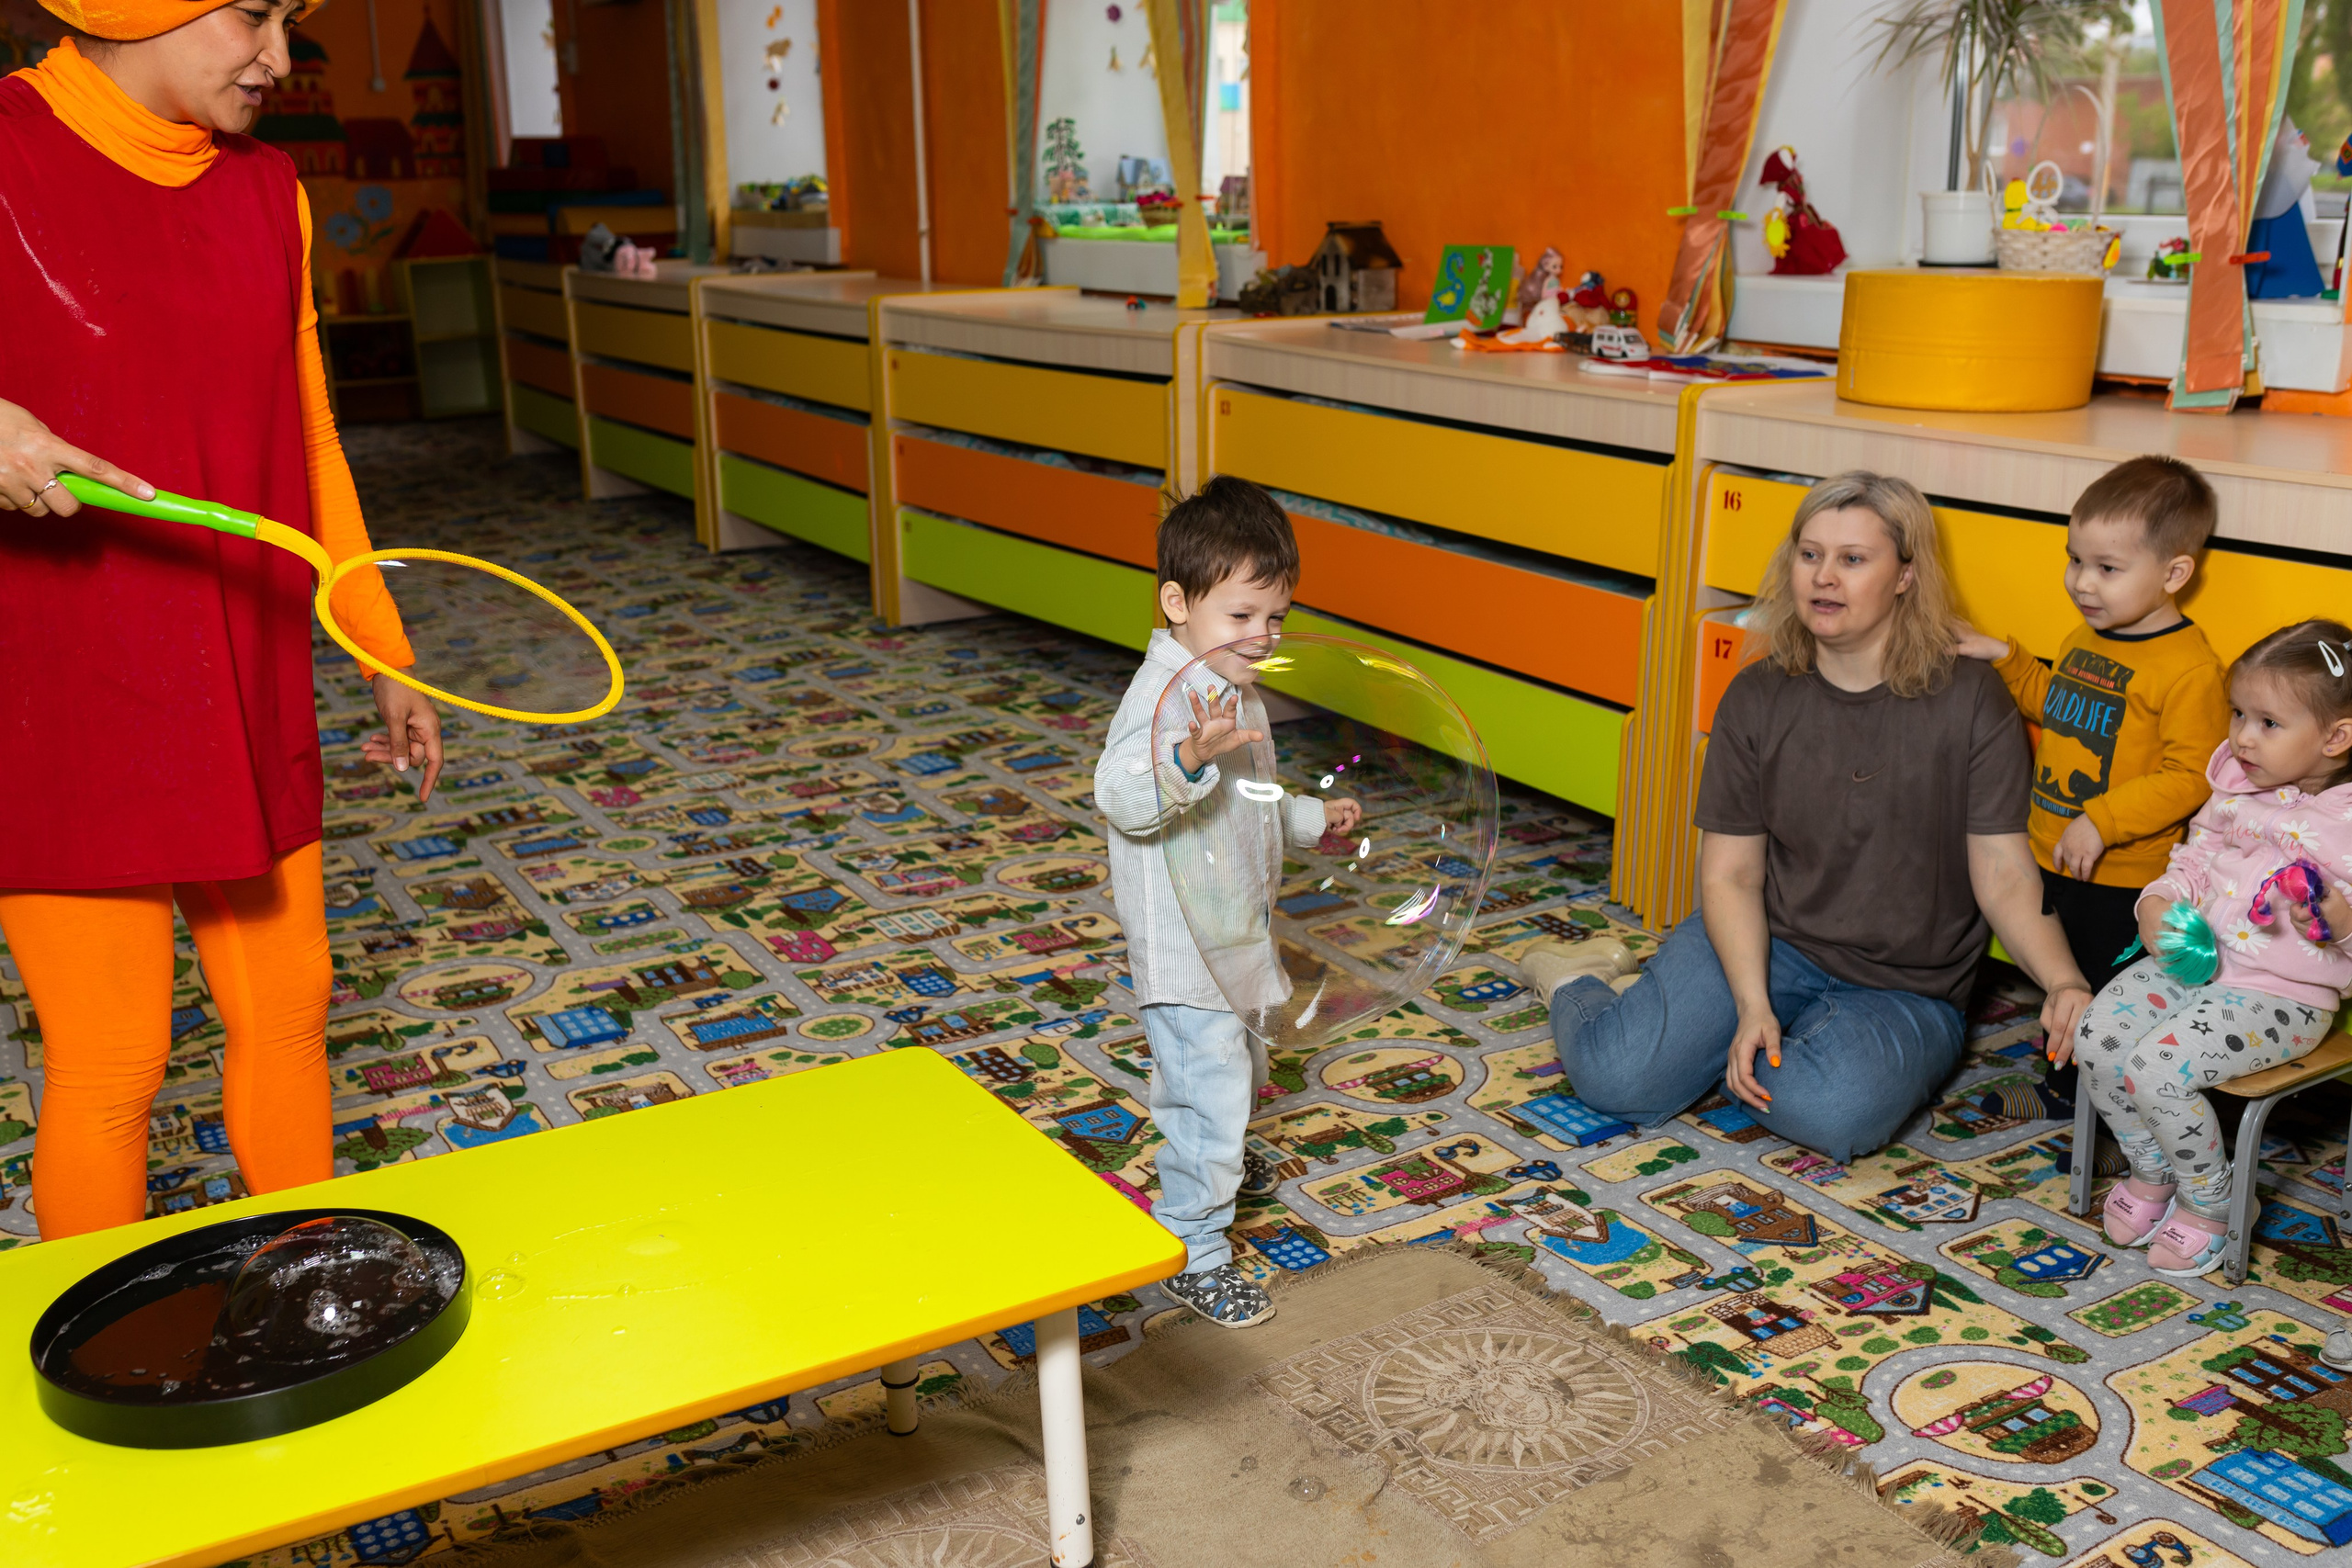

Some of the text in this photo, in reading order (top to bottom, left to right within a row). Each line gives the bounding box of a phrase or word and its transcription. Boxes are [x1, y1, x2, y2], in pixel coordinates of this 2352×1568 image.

[1723, 490, 1742, 512] 16
[1714, 637, 1733, 660] 17
[2043, 683, 2117, 738] WILDLIFE
